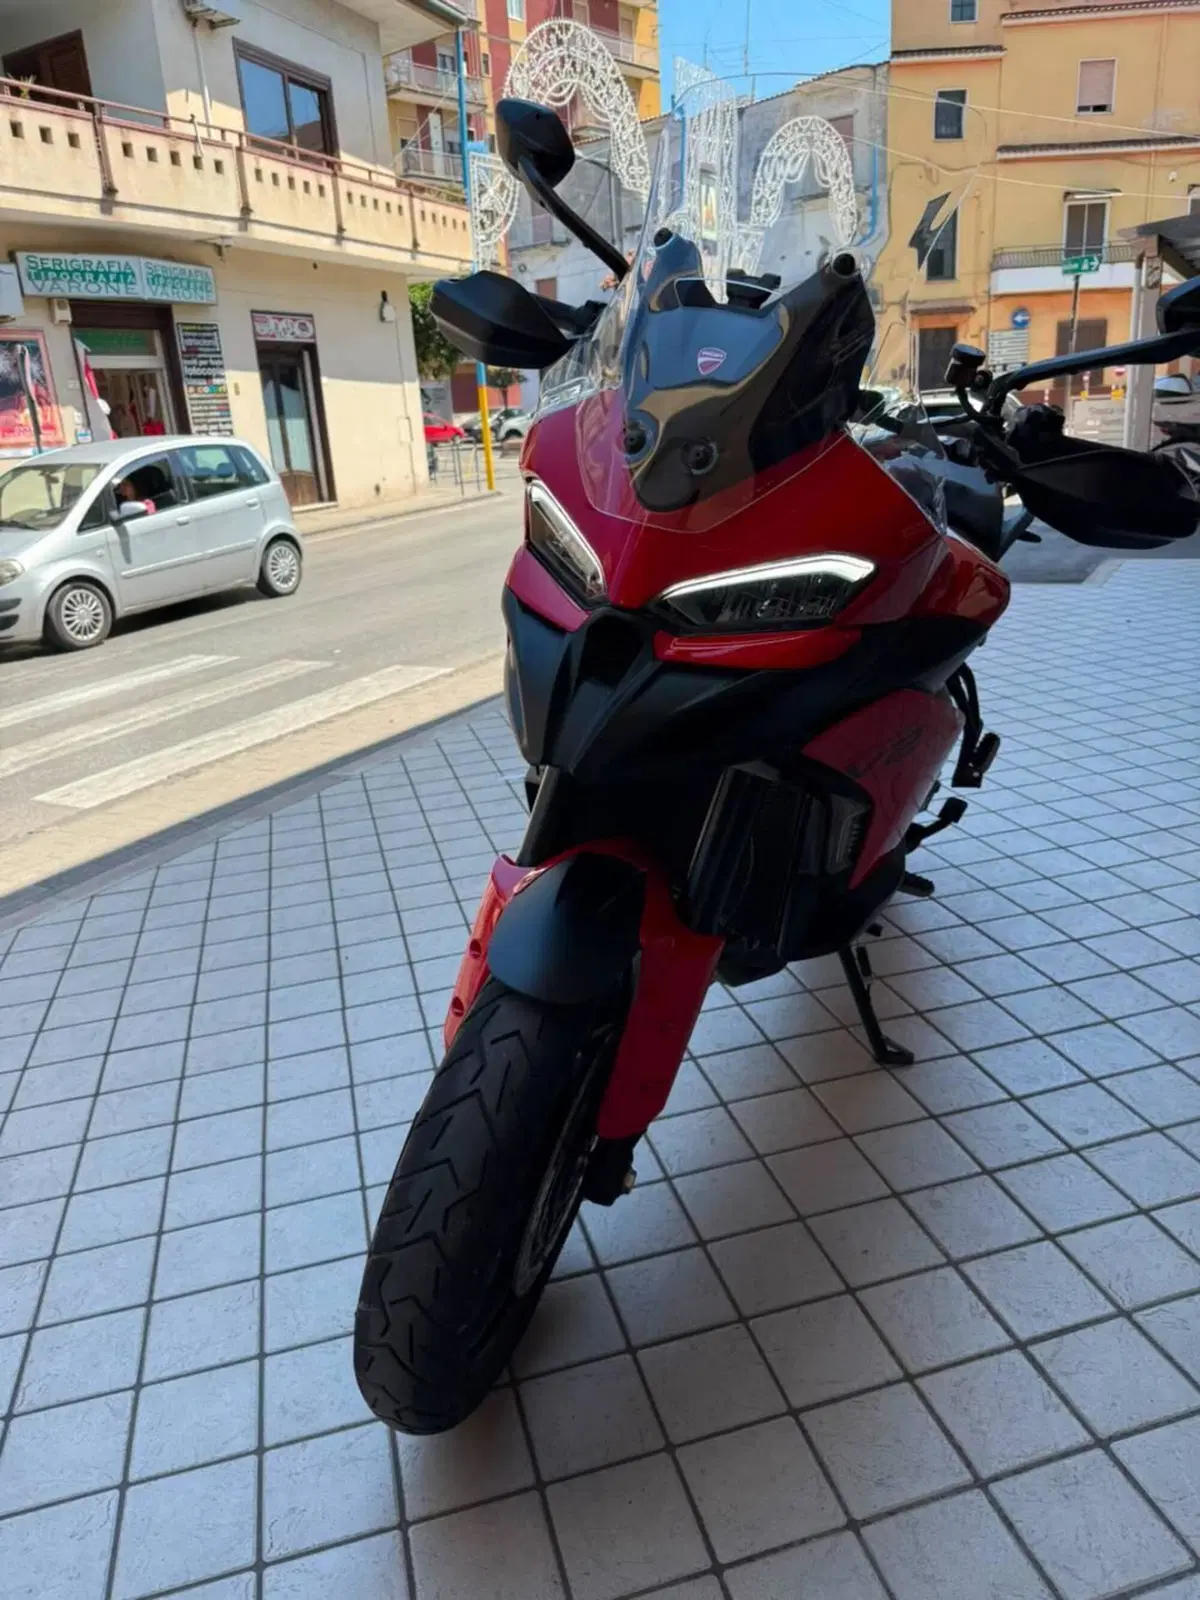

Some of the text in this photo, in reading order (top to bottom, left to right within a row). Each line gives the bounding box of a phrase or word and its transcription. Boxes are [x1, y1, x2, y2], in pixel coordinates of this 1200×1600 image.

[25, 255, 134, 272] SERIGRAFIA
[29, 269, 136, 285] TIPOGRAFIA
[30, 280, 140, 295] VARONE
